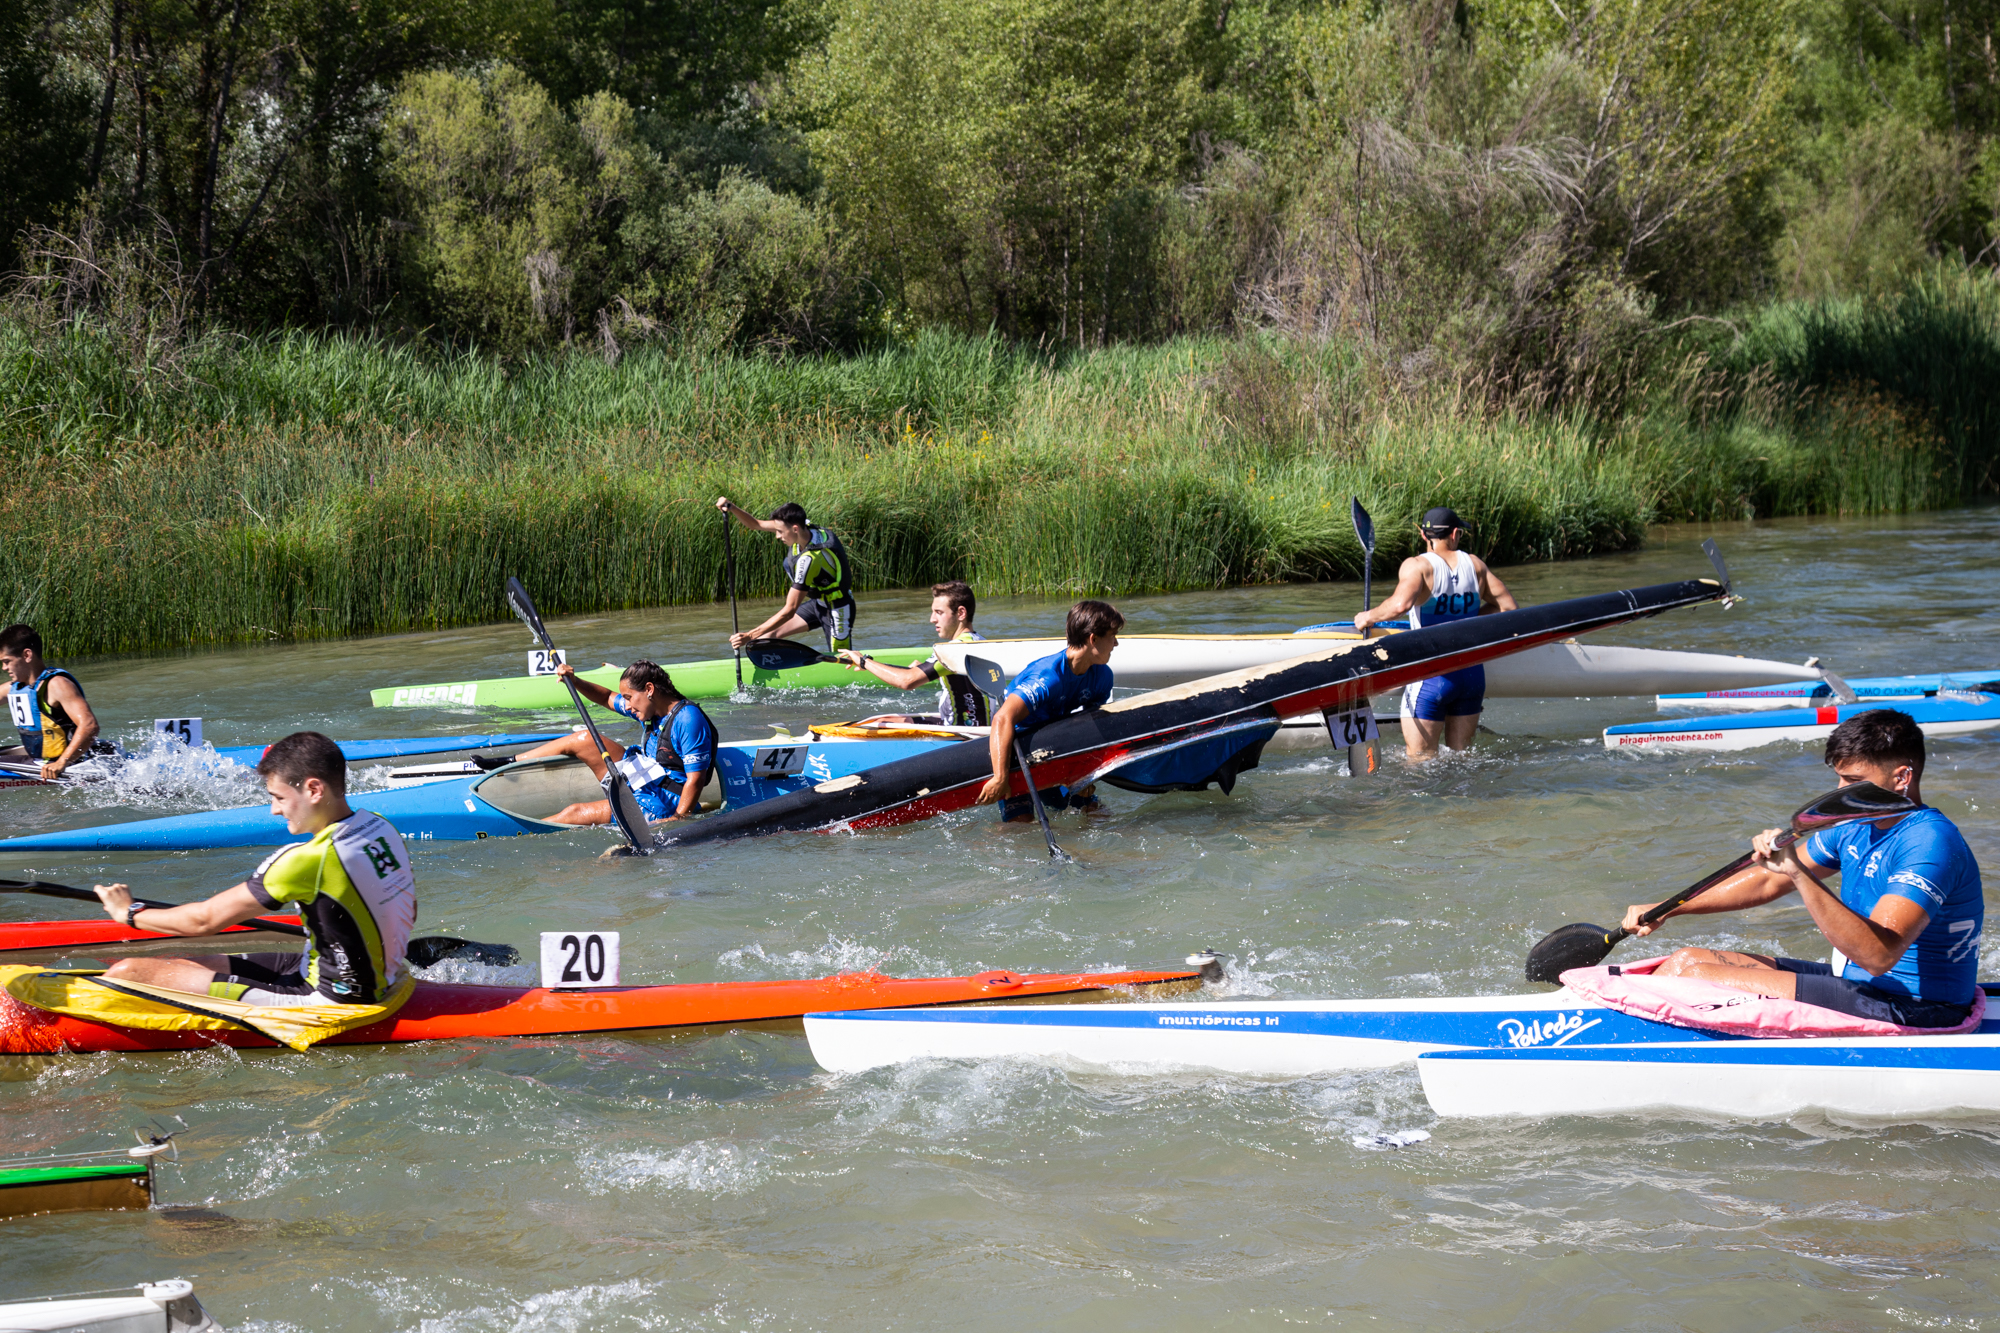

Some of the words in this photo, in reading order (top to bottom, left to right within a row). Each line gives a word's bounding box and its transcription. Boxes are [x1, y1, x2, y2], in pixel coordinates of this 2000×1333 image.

[1434, 591, 1475, 615] BCP
[1340, 711, 1368, 745] 42
[763, 747, 796, 769] 47
[560, 934, 605, 982] 20
